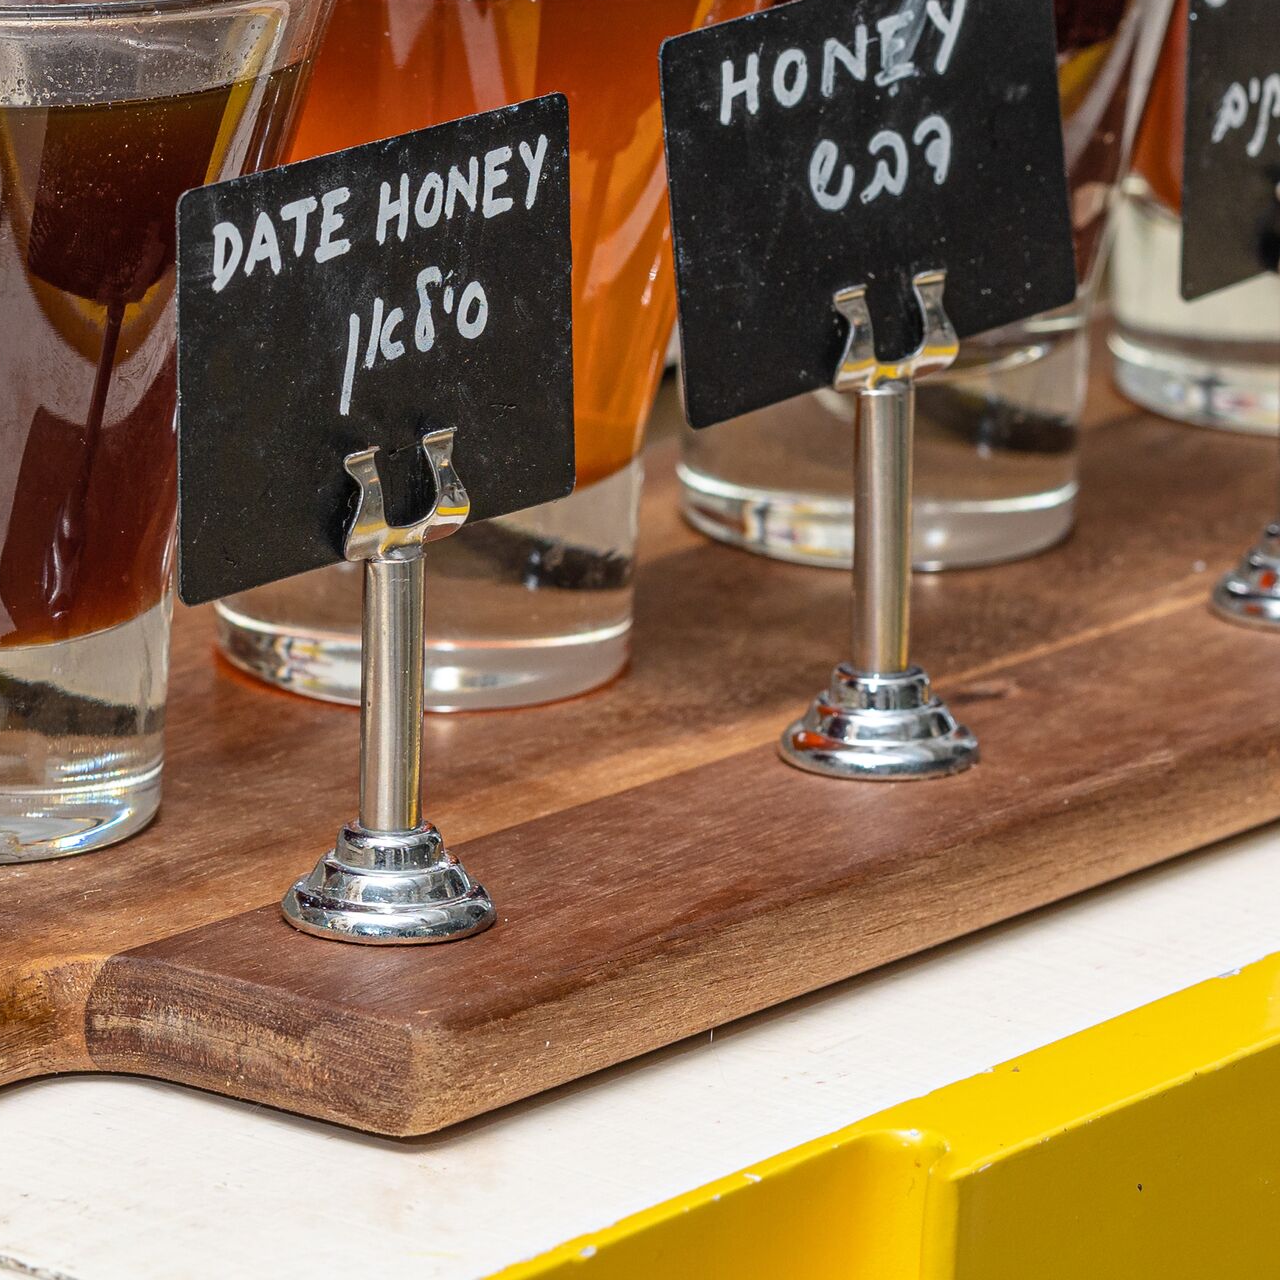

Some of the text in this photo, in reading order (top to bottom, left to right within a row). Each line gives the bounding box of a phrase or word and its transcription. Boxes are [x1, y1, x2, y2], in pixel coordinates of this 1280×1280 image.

[211, 133, 549, 293] DATE HONEY
[808, 114, 952, 211] דבש
